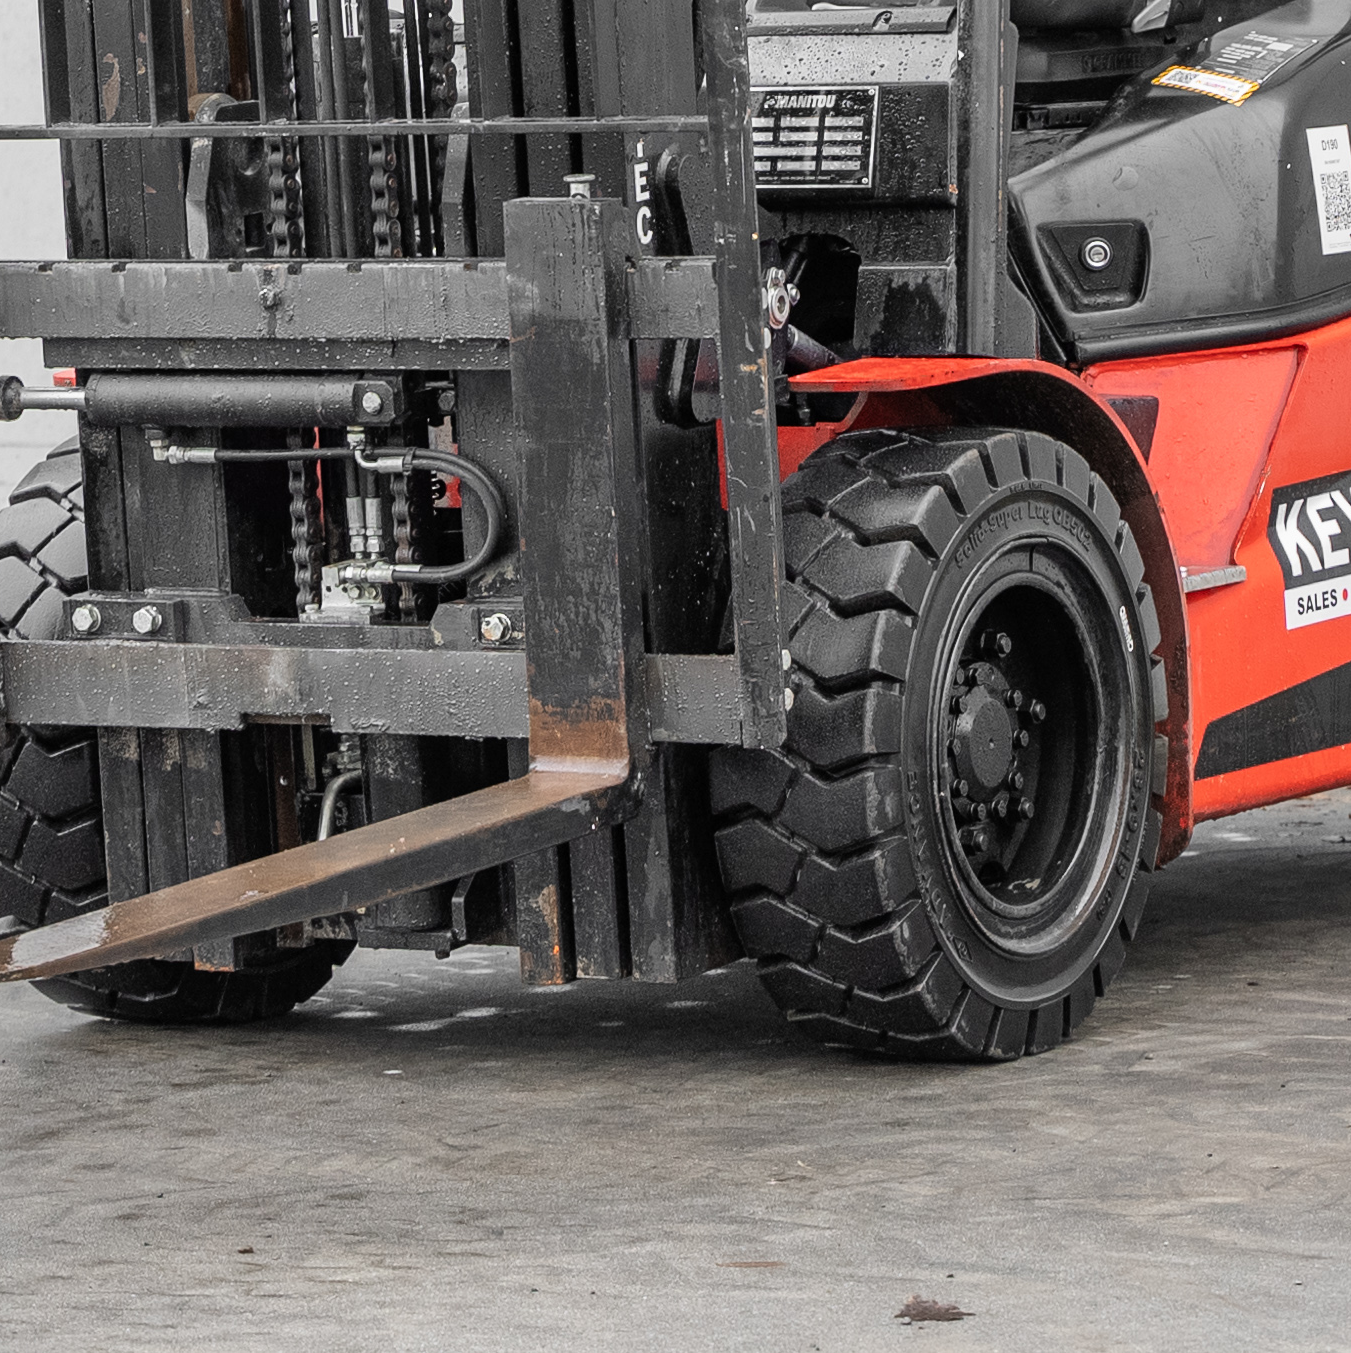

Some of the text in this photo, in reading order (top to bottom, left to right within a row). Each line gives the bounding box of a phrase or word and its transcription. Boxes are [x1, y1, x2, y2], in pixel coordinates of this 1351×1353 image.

[775, 95, 836, 108] MANITOU
[1321, 139, 1338, 151] D190
[1027, 500, 1050, 526] Lug
[1297, 589, 1338, 615] SALES
